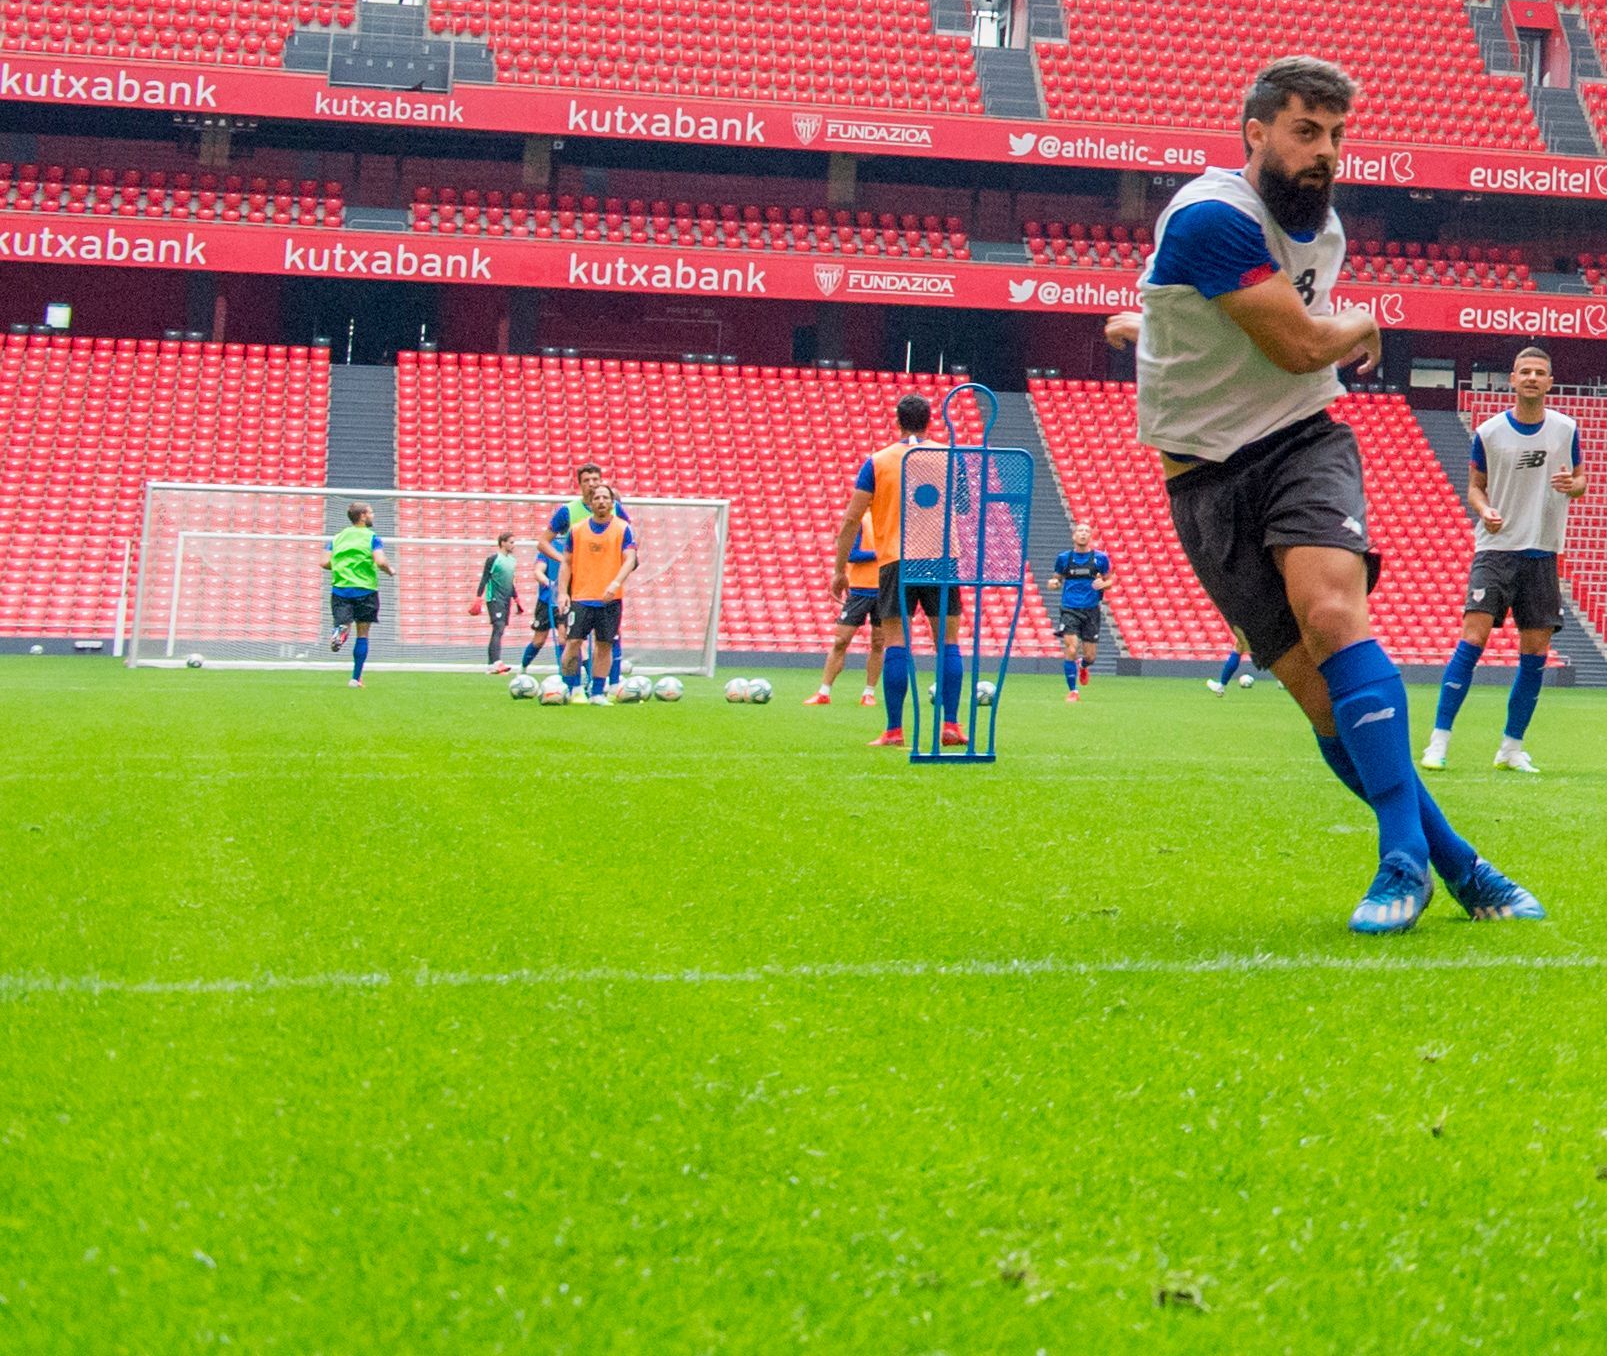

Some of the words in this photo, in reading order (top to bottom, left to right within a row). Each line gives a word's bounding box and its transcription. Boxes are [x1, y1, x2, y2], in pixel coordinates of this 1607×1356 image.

[1, 62, 217, 107] kutxabank
[316, 92, 464, 123] kutxabank
[569, 99, 765, 143] kutxabank
[827, 125, 933, 146] FUNDAZIOA
[1038, 135, 1207, 167] @athletic_eus
[1470, 165, 1590, 194] euskaltel
[285, 239, 491, 279] kutxabank
[570, 252, 767, 293] kutxabank
[848, 275, 955, 293] FUNDAZIOA
[1460, 305, 1580, 334] euskaltel
